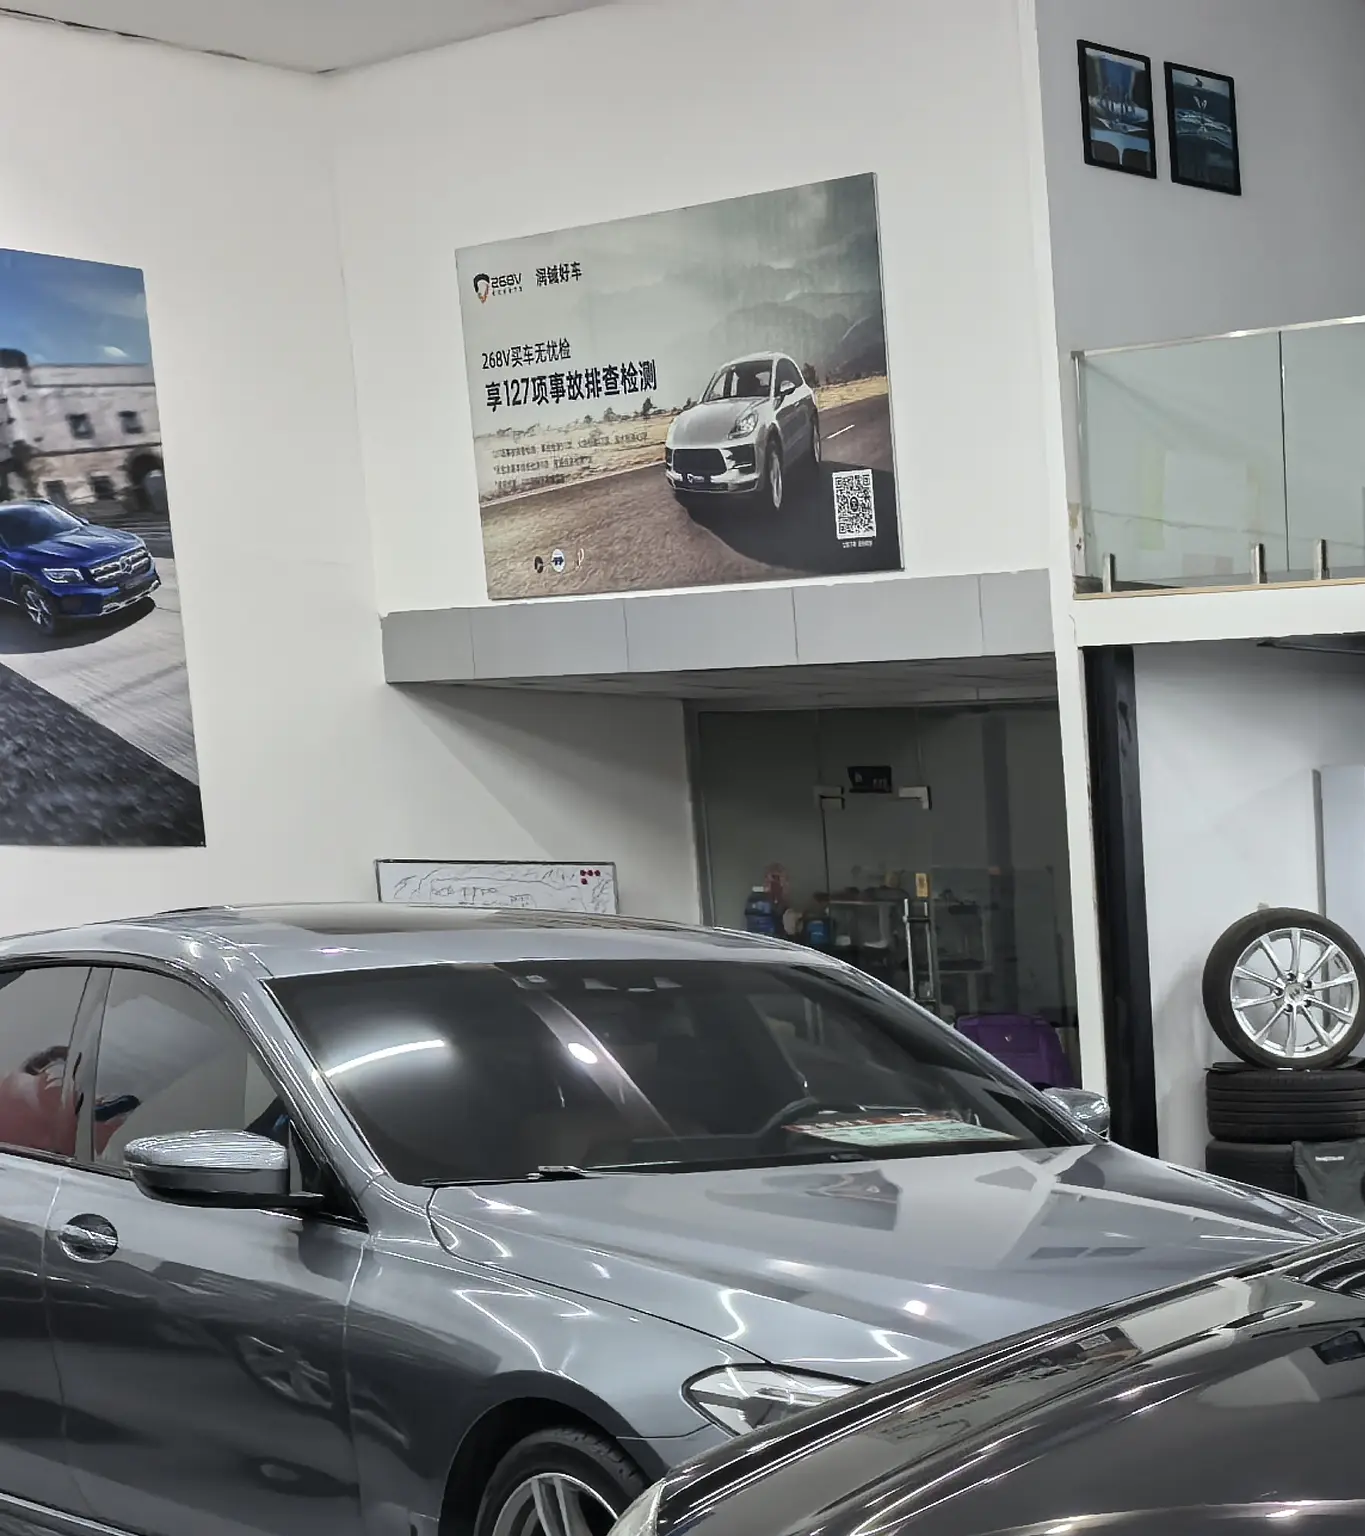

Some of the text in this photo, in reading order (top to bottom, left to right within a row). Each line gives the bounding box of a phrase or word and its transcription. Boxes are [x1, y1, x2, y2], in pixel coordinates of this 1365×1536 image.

[482, 337, 571, 370] 268V买车无忧检
[485, 359, 657, 412] 享127项事故排查检测
